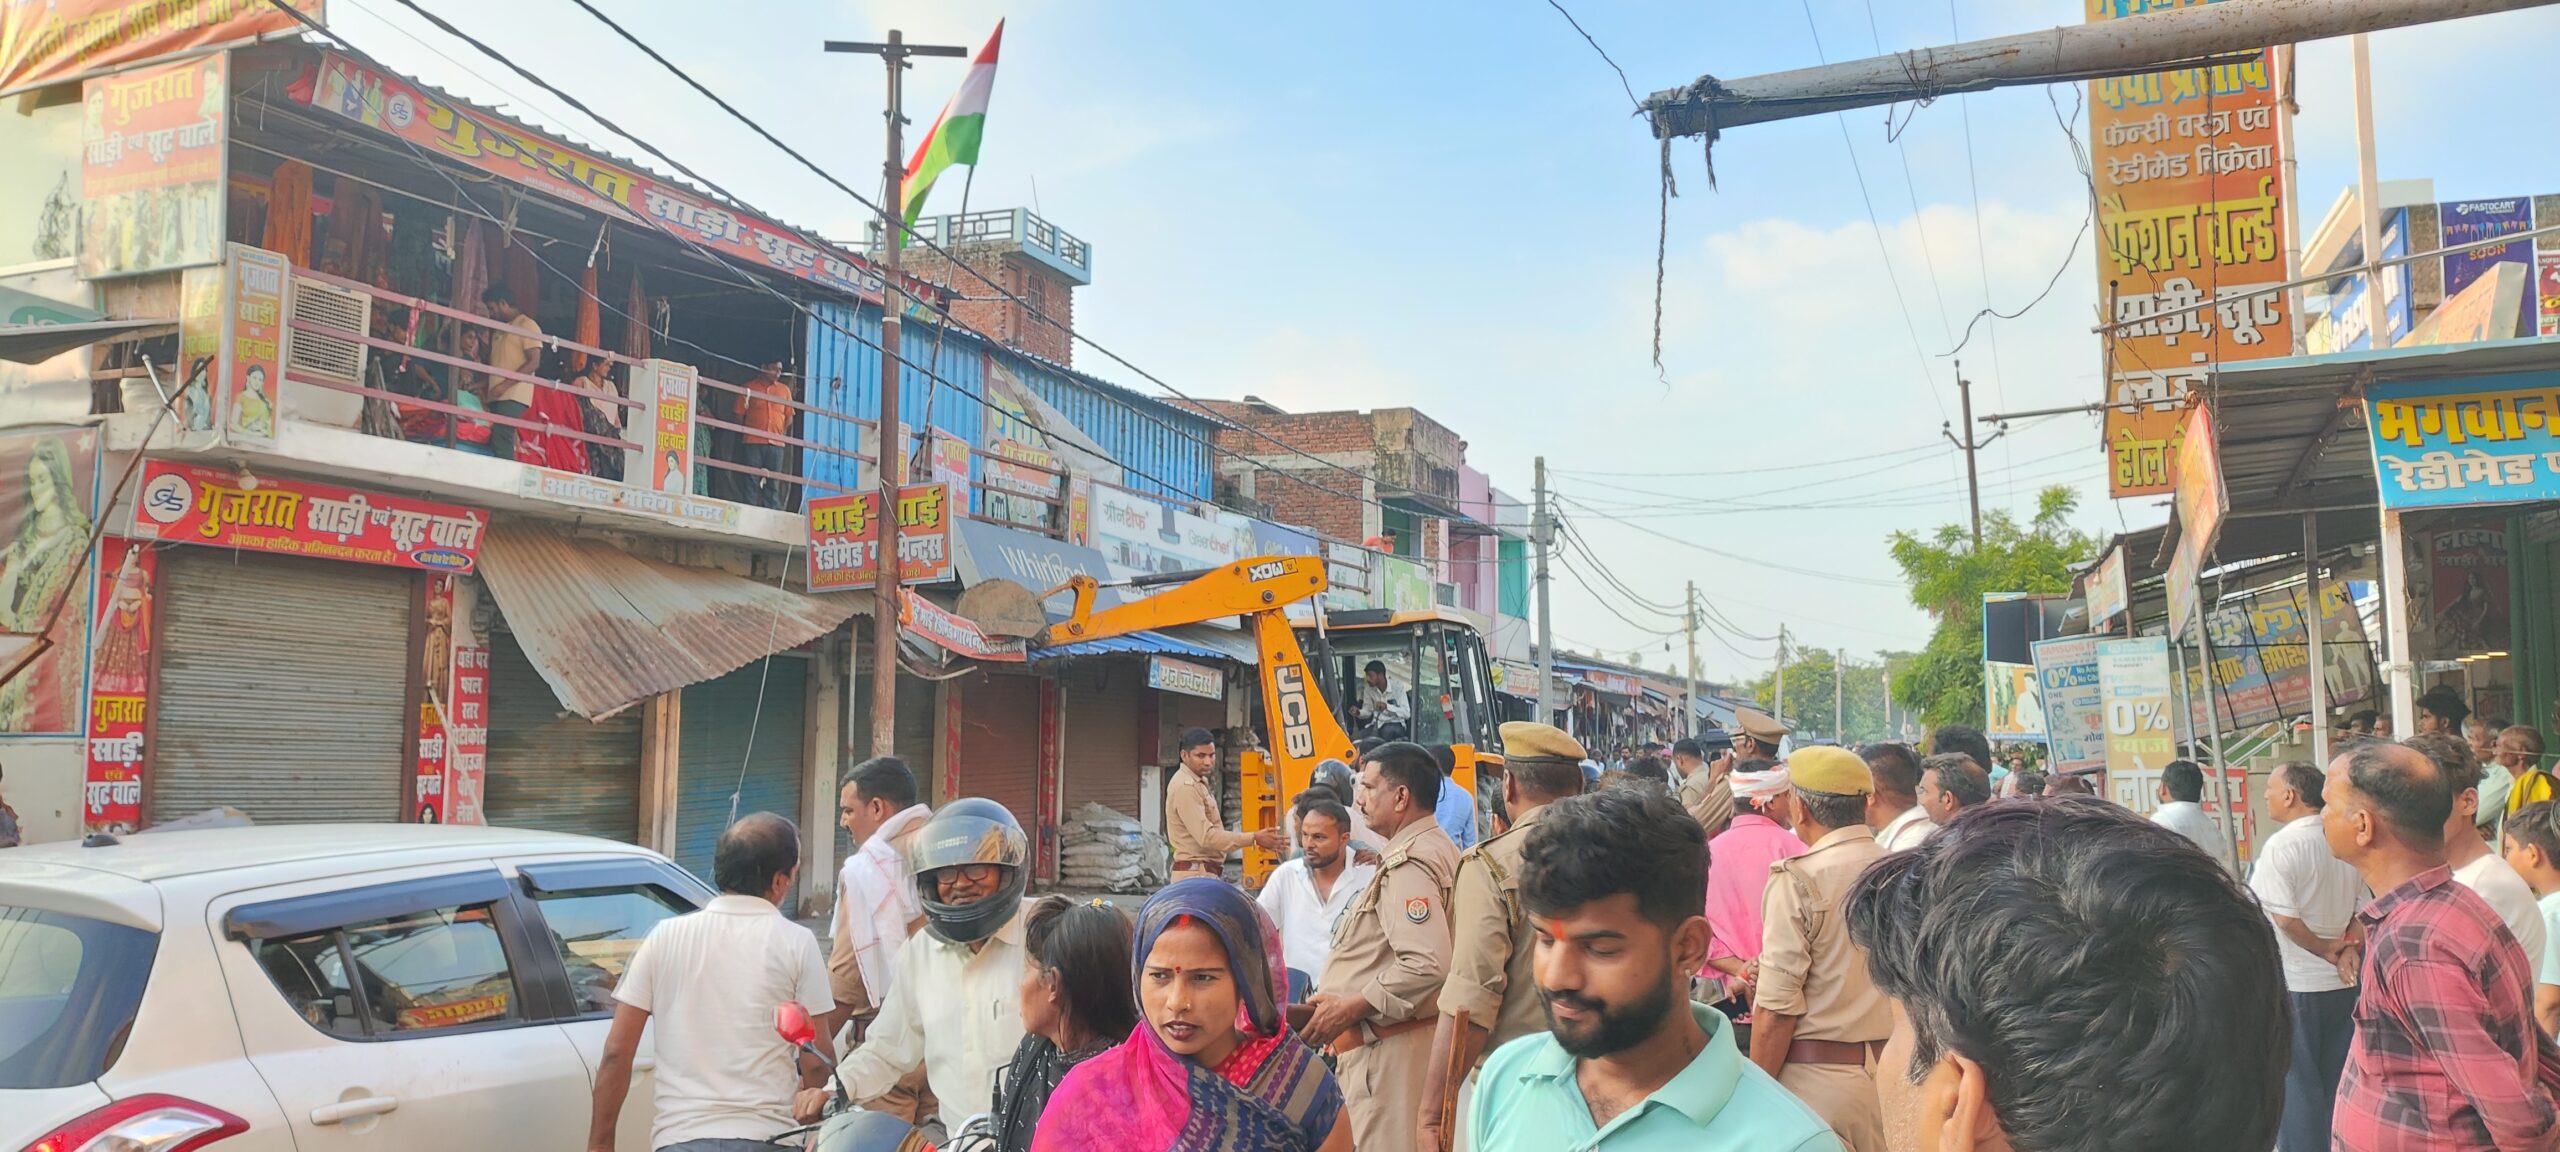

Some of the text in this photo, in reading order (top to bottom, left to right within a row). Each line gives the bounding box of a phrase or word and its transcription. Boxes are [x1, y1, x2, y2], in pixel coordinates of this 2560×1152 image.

[109, 66, 195, 126] गुजरात
[2237, 100, 2272, 131] एवं
[146, 127, 176, 164] सूट
[177, 114, 217, 148] वाले
[423, 96, 637, 206] गुजरात
[752, 228, 818, 270] सूट
[2107, 141, 2274, 187] रेडीमेड विक्रेता
[2101, 175, 2278, 275] फैशन वर्ल्ड
[2469, 244, 2507, 261] SOON
[2216, 282, 2281, 345] सूट
[2114, 428, 2167, 487] होल
[2380, 449, 2536, 491] रेडीमेड
[199, 480, 303, 538] गुजरात
[307, 494, 371, 542] साड़ी
[390, 509, 432, 552] सूट
[431, 511, 482, 550] वाले
[812, 536, 864, 571] रेडीमेड
[476, 653, 489, 669] पर
[2047, 667, 2078, 688] 0%
[460, 677, 483, 694] फाल
[1275, 665, 1314, 759] JCB
[2107, 700, 2170, 736] 0%
[419, 733, 443, 763] साड़ी
[87, 781, 111, 814] सूट
